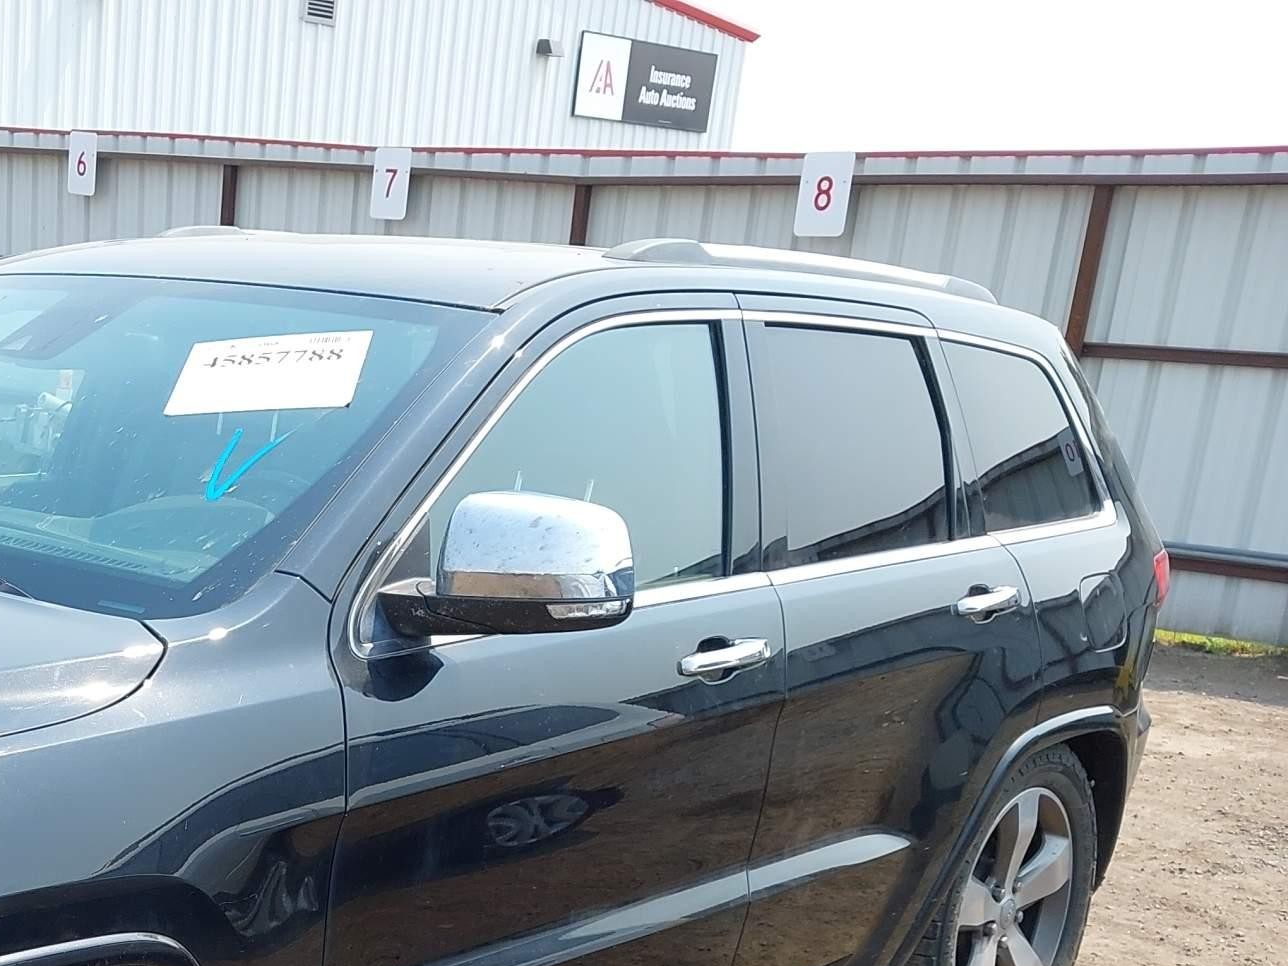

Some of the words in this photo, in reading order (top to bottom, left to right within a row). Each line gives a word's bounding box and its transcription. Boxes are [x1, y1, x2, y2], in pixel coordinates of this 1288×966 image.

[649, 64, 692, 89] Insurance
[638, 86, 660, 106] Auto
[659, 89, 697, 111] Auctions
[77, 151, 87, 176] 6
[385, 168, 399, 198] 7
[814, 175, 833, 211] 8
[203, 348, 345, 368] 45857788
